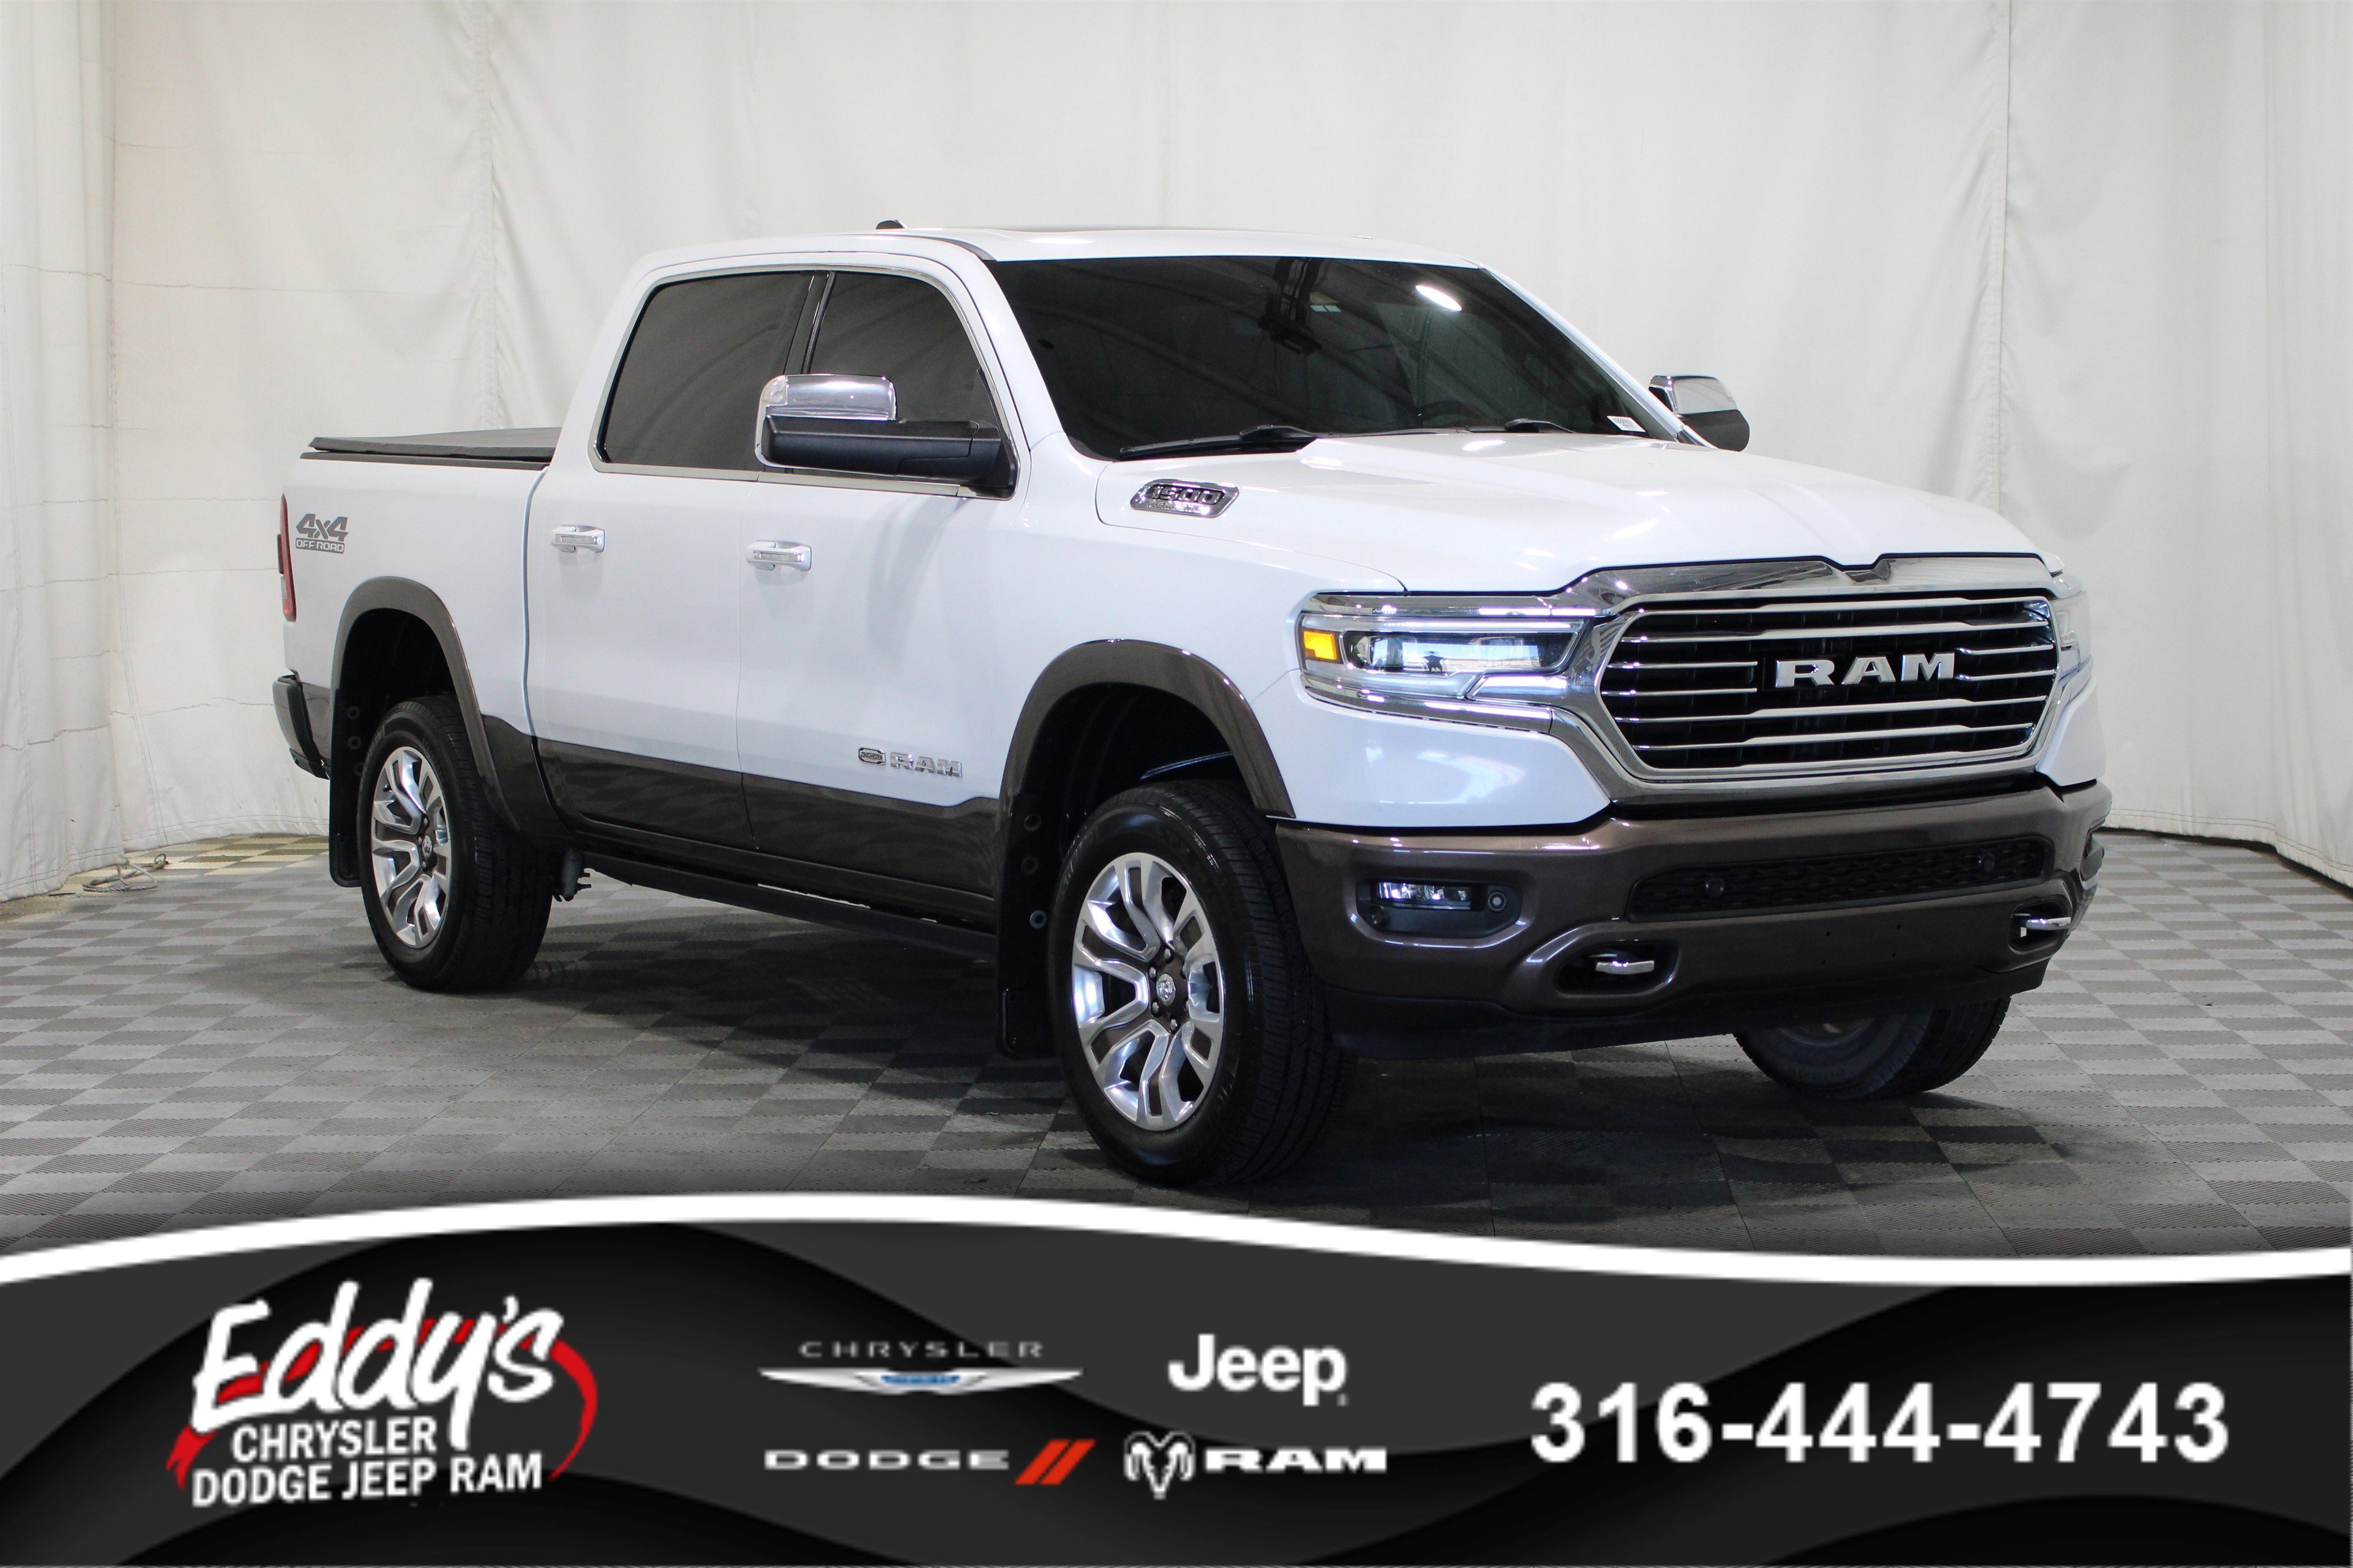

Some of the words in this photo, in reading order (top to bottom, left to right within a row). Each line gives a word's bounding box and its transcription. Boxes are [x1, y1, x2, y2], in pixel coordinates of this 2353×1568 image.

[1150, 486, 1221, 505] 1500
[296, 540, 315, 549] OFF
[317, 541, 344, 552] ROAD
[1776, 652, 1954, 688] RAM
[890, 752, 962, 778] RAM
